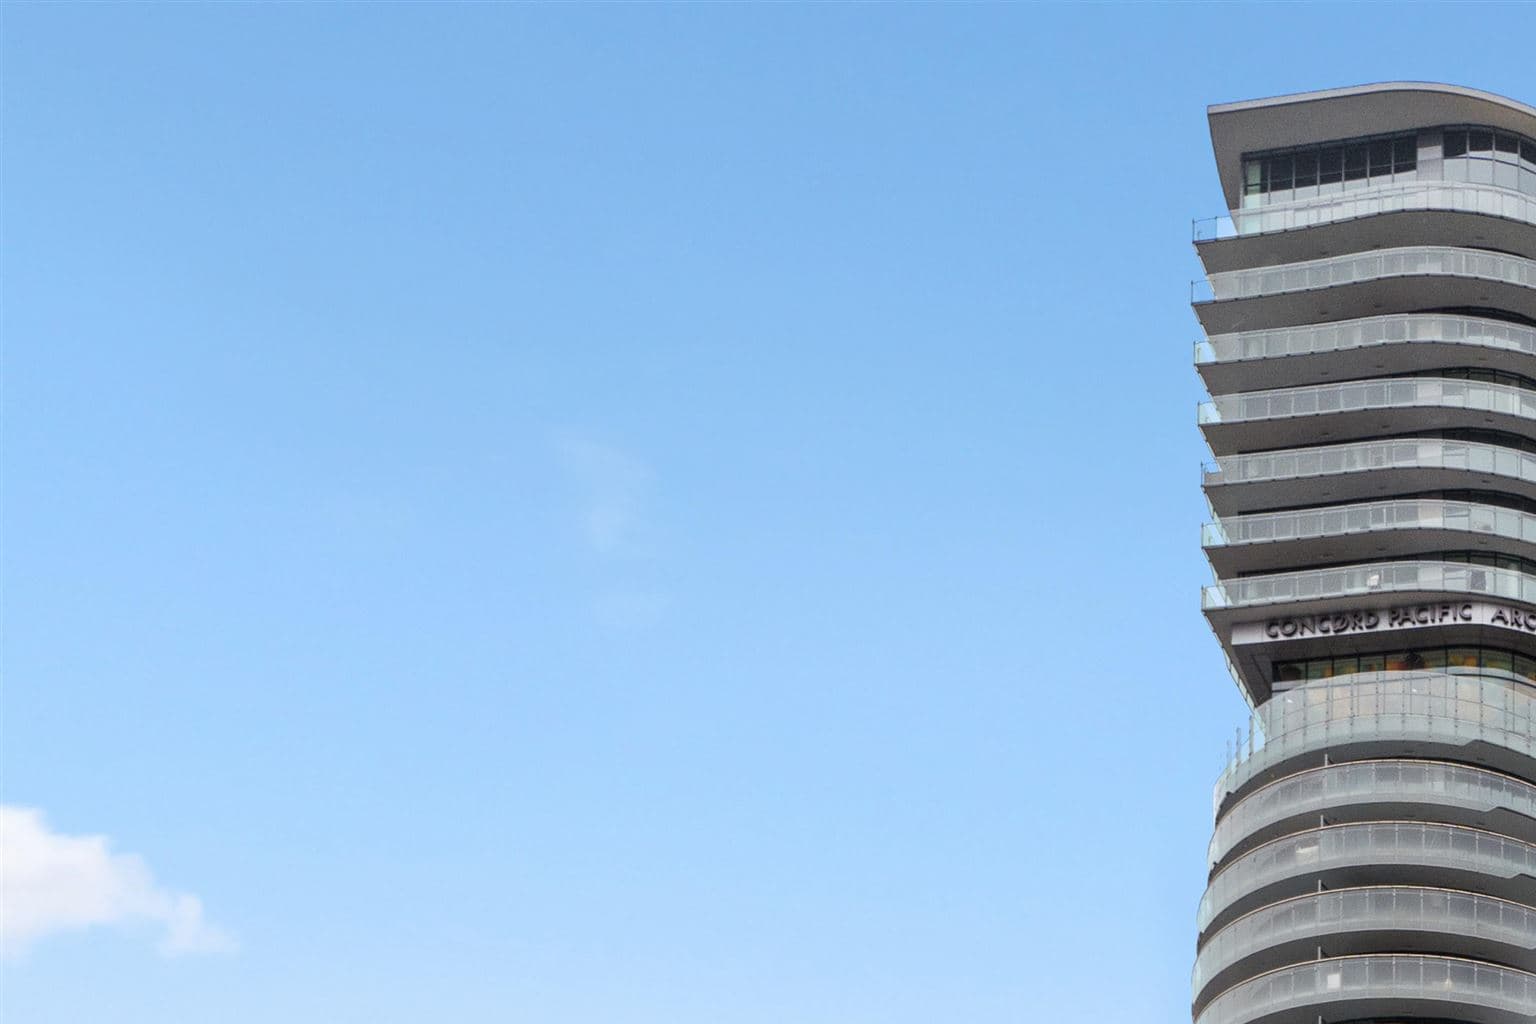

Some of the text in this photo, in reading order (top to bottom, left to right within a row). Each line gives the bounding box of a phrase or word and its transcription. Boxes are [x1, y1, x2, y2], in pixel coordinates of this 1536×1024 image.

[1265, 604, 1536, 638] CONCORD PACIFIC ARC
